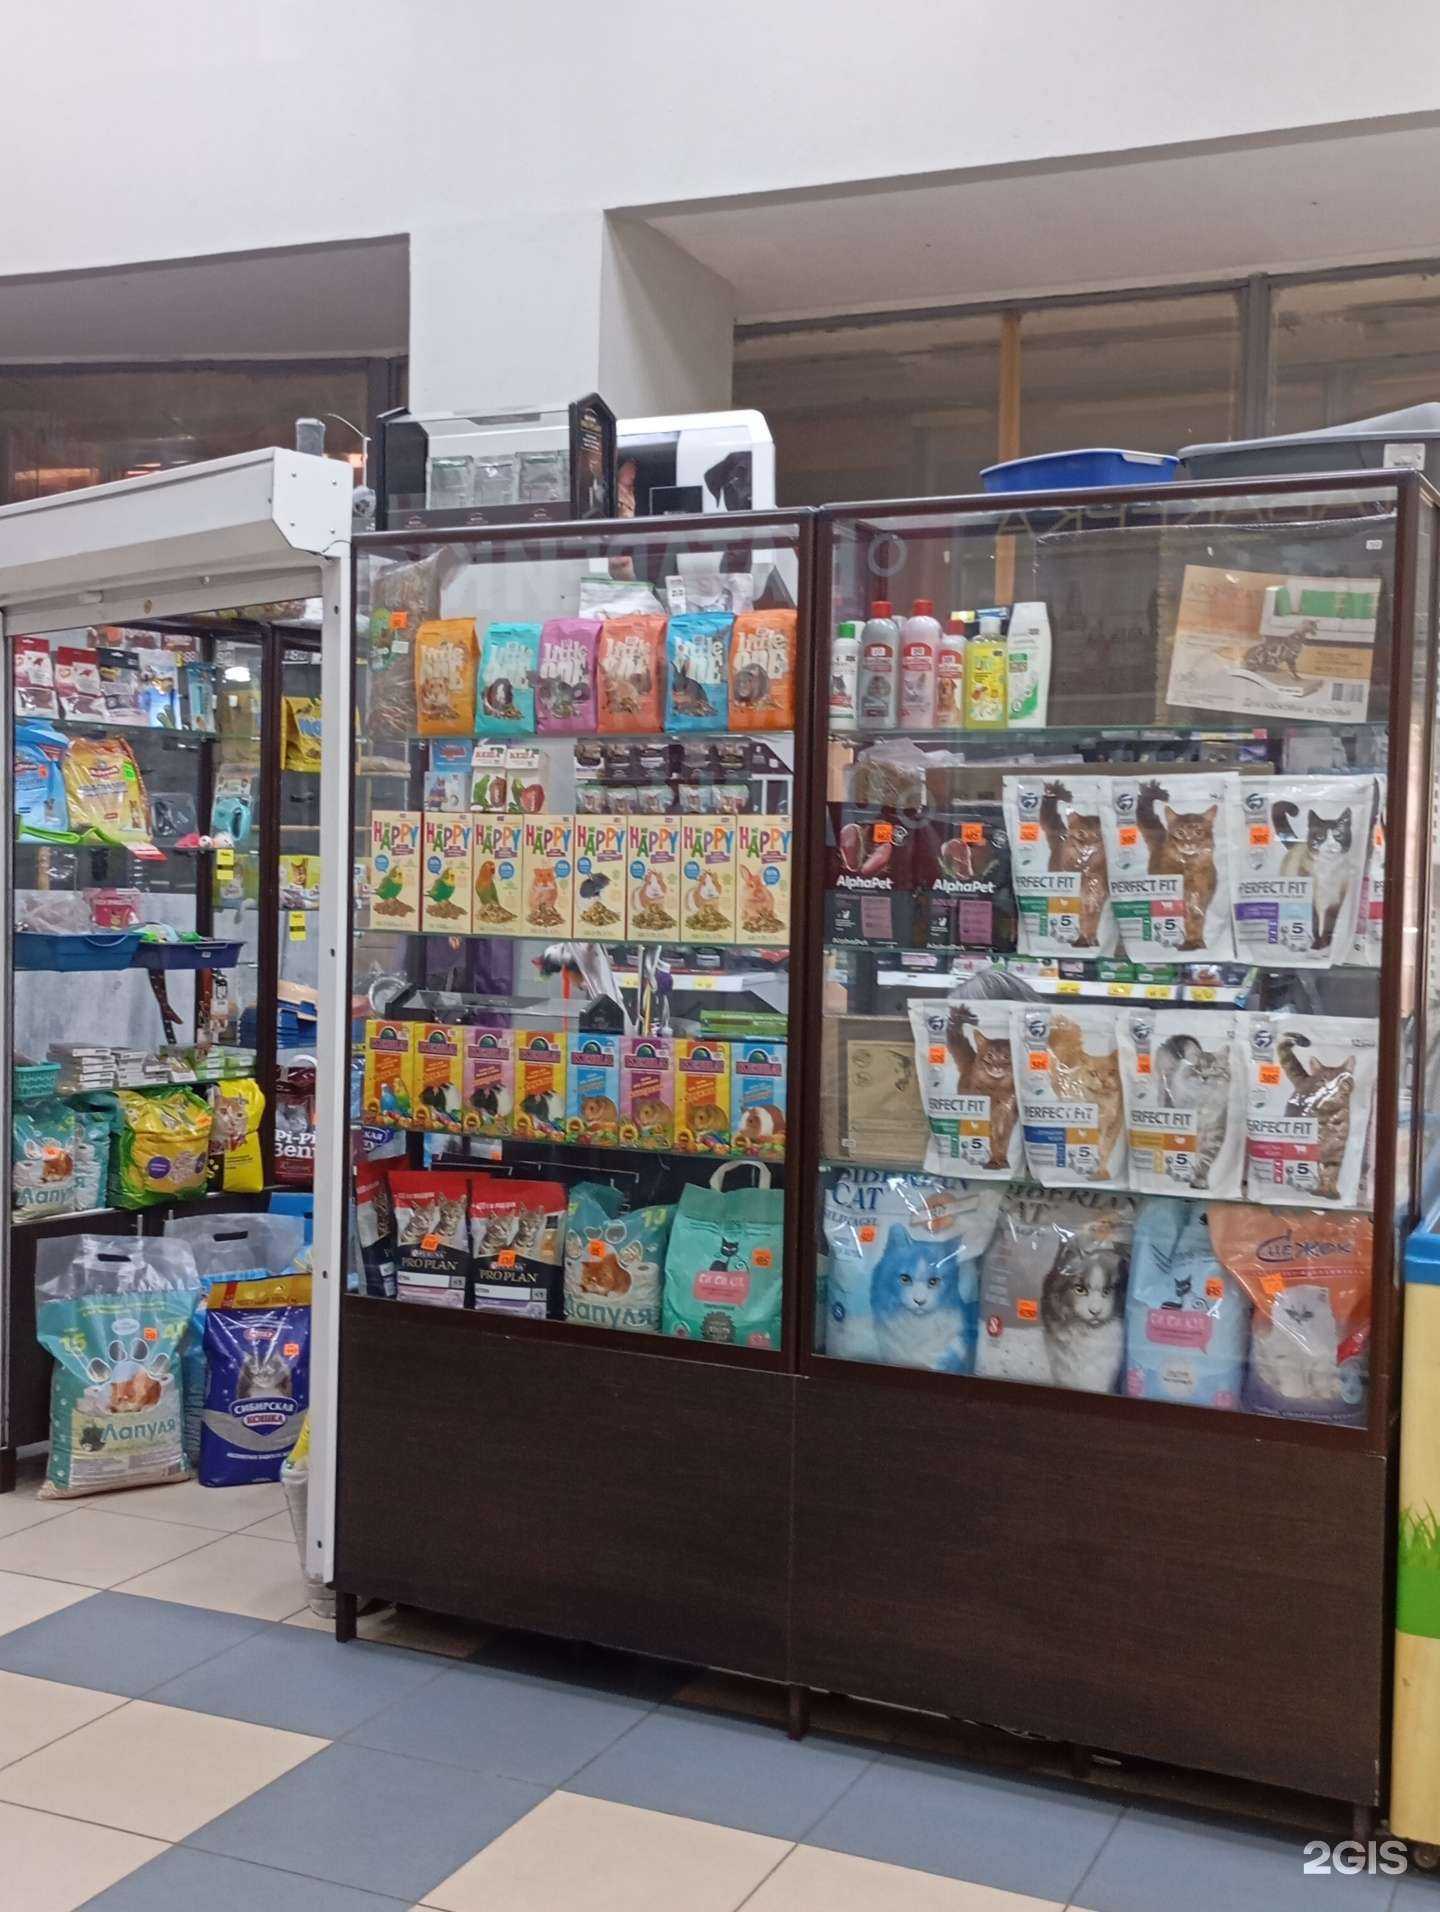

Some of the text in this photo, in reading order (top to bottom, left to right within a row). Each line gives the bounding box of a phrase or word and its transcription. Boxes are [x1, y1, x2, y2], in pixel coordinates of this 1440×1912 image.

[836, 874, 895, 890] AlphaPet
[932, 878, 997, 894] AlphaPet
[1058, 876, 1075, 889] FIT
[1159, 879, 1178, 893] FIT
[1288, 881, 1308, 895] FIT
[967, 1099, 986, 1113] FIT
[1075, 1106, 1094, 1120] FIT
[1173, 1111, 1192, 1126] FIT
[1293, 1121, 1313, 1136] FIT
[274, 1129, 316, 1145] Pi-Pi
[832, 1182, 884, 1210] CAT
[401, 1257, 456, 1271] PRO PLAN
[480, 1269, 537, 1284] PRO PLAN
[234, 1401, 294, 1415] СИБИРСКАЯ
[246, 1414, 283, 1424] КОШКА
[100, 1417, 177, 1442] Лапуля
